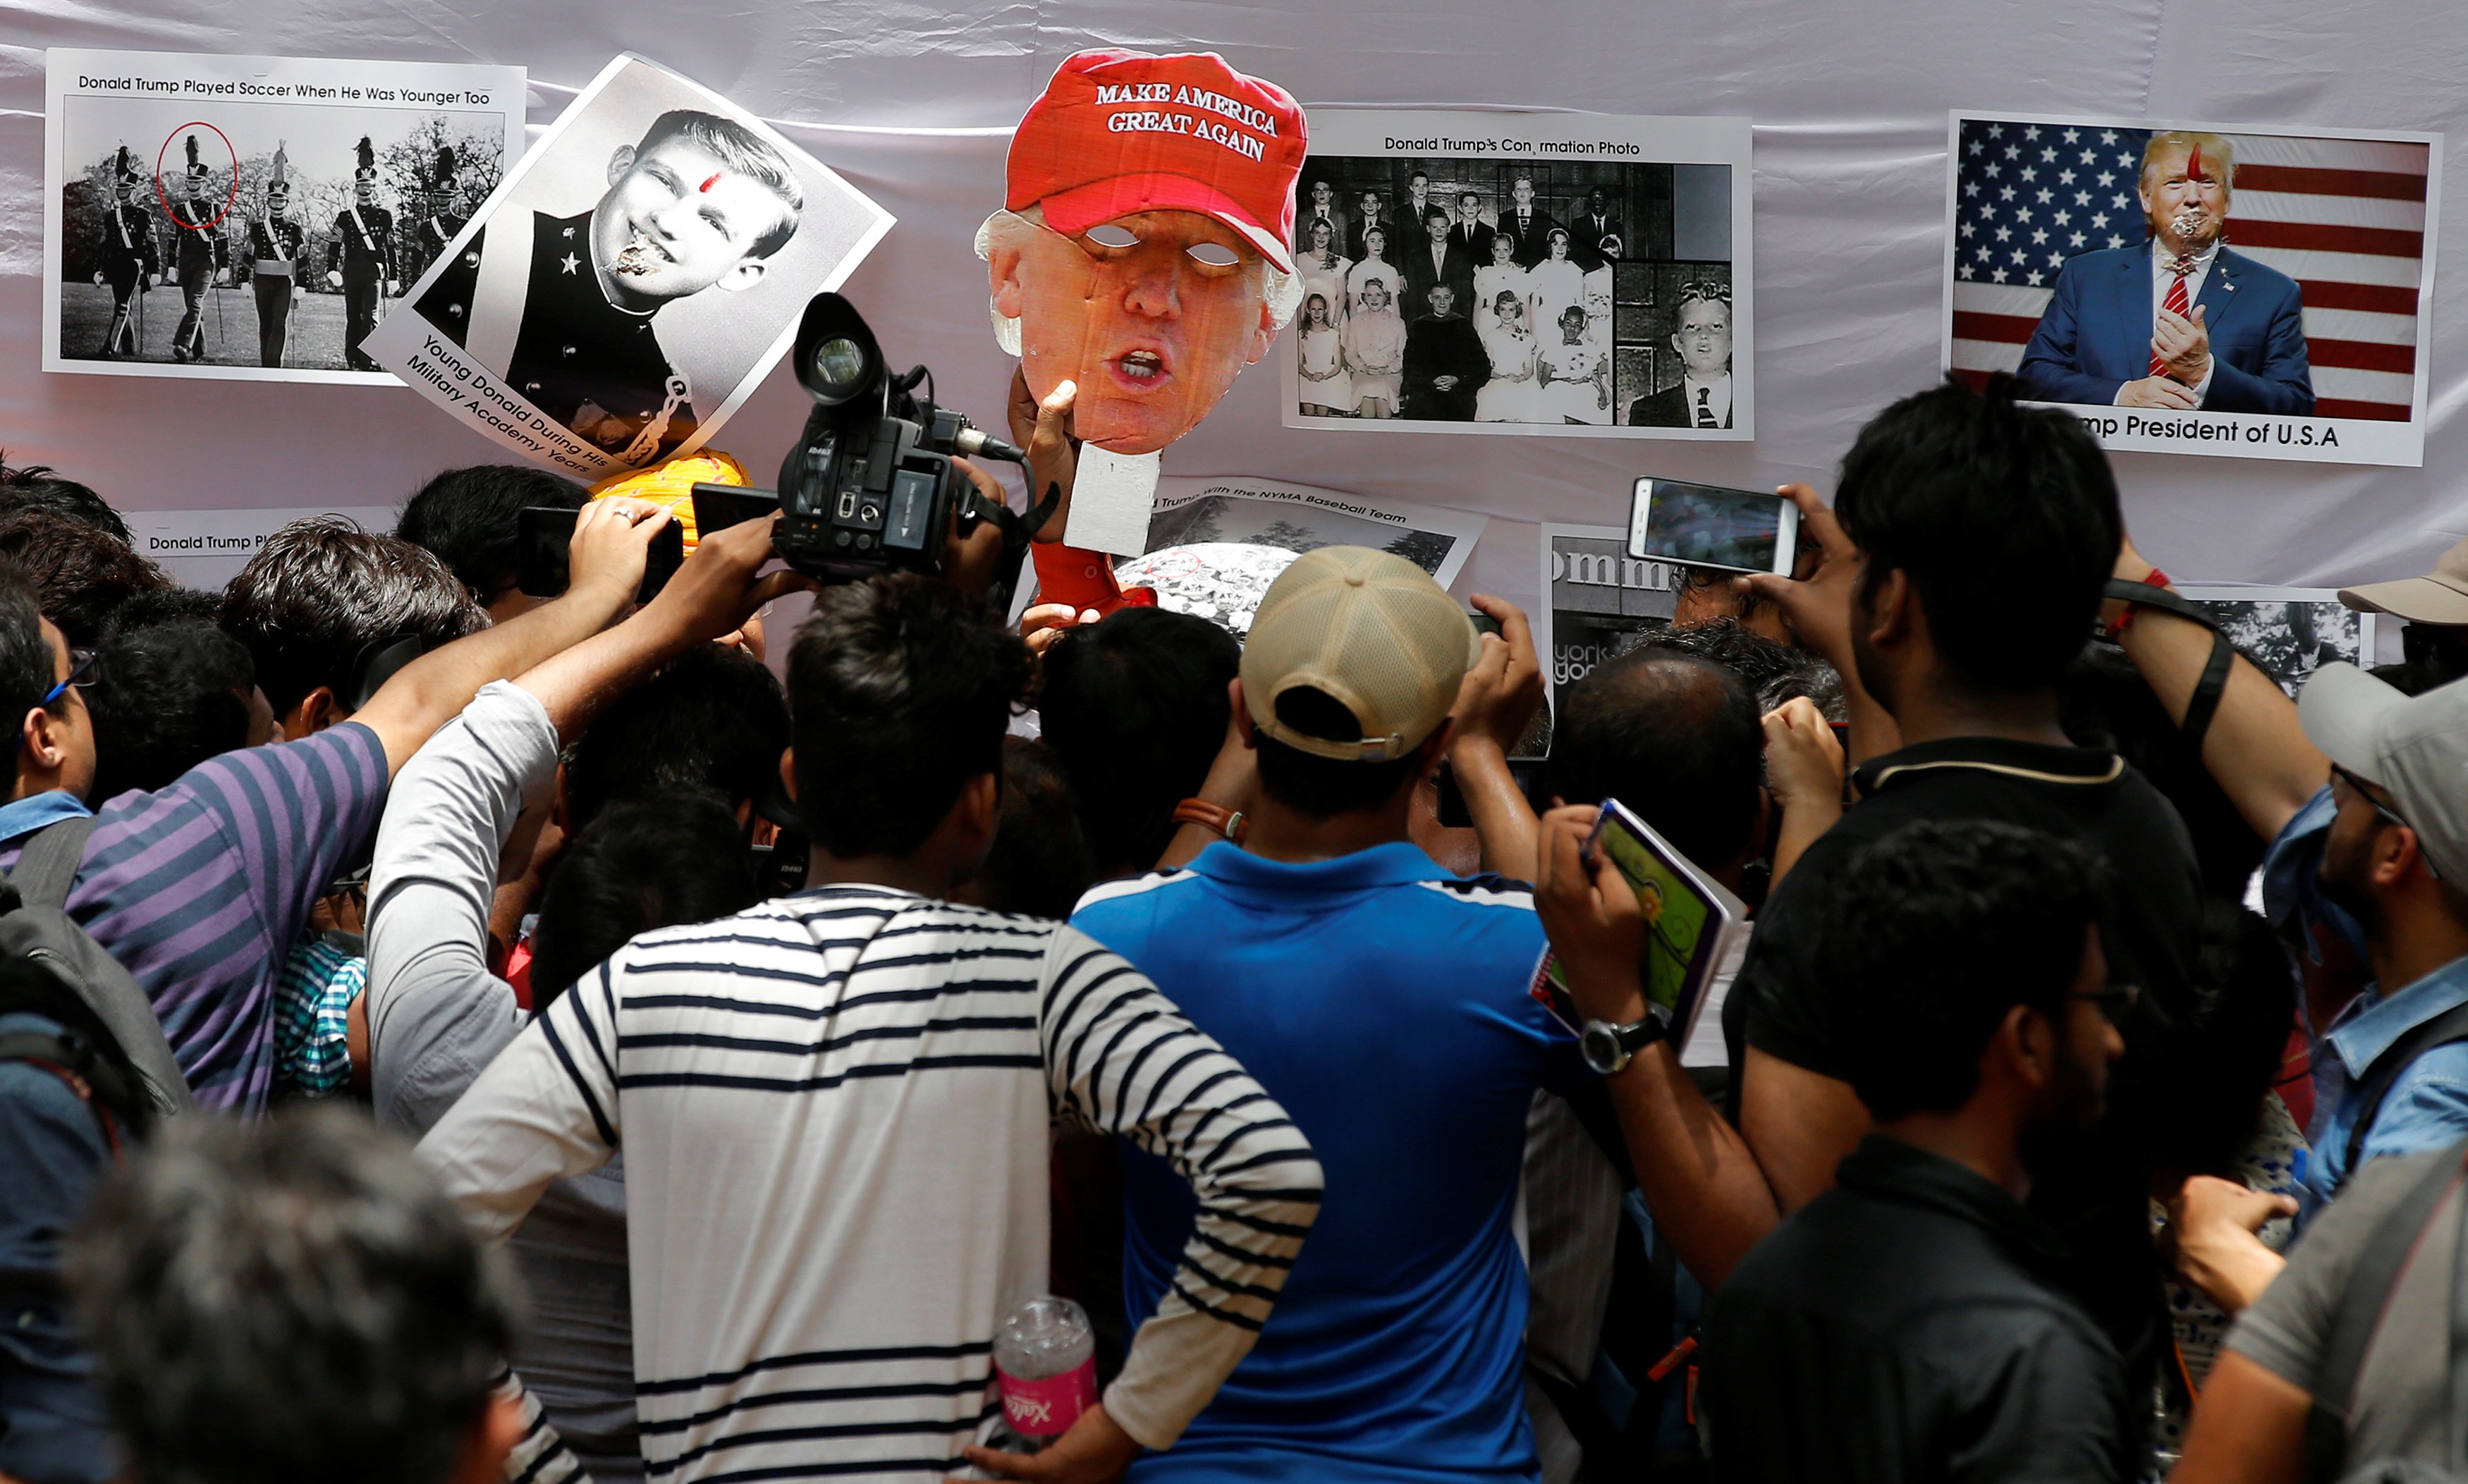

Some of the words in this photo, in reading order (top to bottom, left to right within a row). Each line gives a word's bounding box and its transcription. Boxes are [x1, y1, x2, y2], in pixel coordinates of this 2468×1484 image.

[79, 75, 131, 90] Donald
[135, 78, 179, 94] Trump
[184, 80, 235, 96] Played
[239, 82, 291, 96] Soccer
[295, 85, 336, 98] When
[341, 87, 360, 99] He
[365, 87, 395, 101] Was
[400, 89, 460, 106] Younger
[465, 91, 489, 104] Too
[1094, 84, 1171, 105] MAKE
[1173, 85, 1278, 138] AMERICA
[1107, 111, 1192, 135] GREAT
[1192, 118, 1266, 163] AGAIN
[1385, 137, 1438, 150] Donald
[1539, 140, 1595, 154] rmation
[1599, 141, 1640, 155] Photo
[407, 355, 465, 402] Military
[464, 400, 545, 453] Academy
[547, 449, 589, 474] Years
[424, 334, 472, 381] Young
[472, 375, 532, 422] Donald
[530, 418, 582, 455] During
[582, 450, 609, 467] His
[2126, 415, 2239, 442] President
[2247, 423, 2270, 443] of
[2277, 424, 2339, 448] U.S.A
[1234, 489, 1256, 497] the
[1259, 491, 1302, 501] NYMA
[1306, 495, 1367, 515] Baseball
[1369, 508, 1407, 524] Team
[150, 536, 202, 550] Donald
[207, 535, 251, 551] Trump
[1553, 662, 1597, 685] yor
